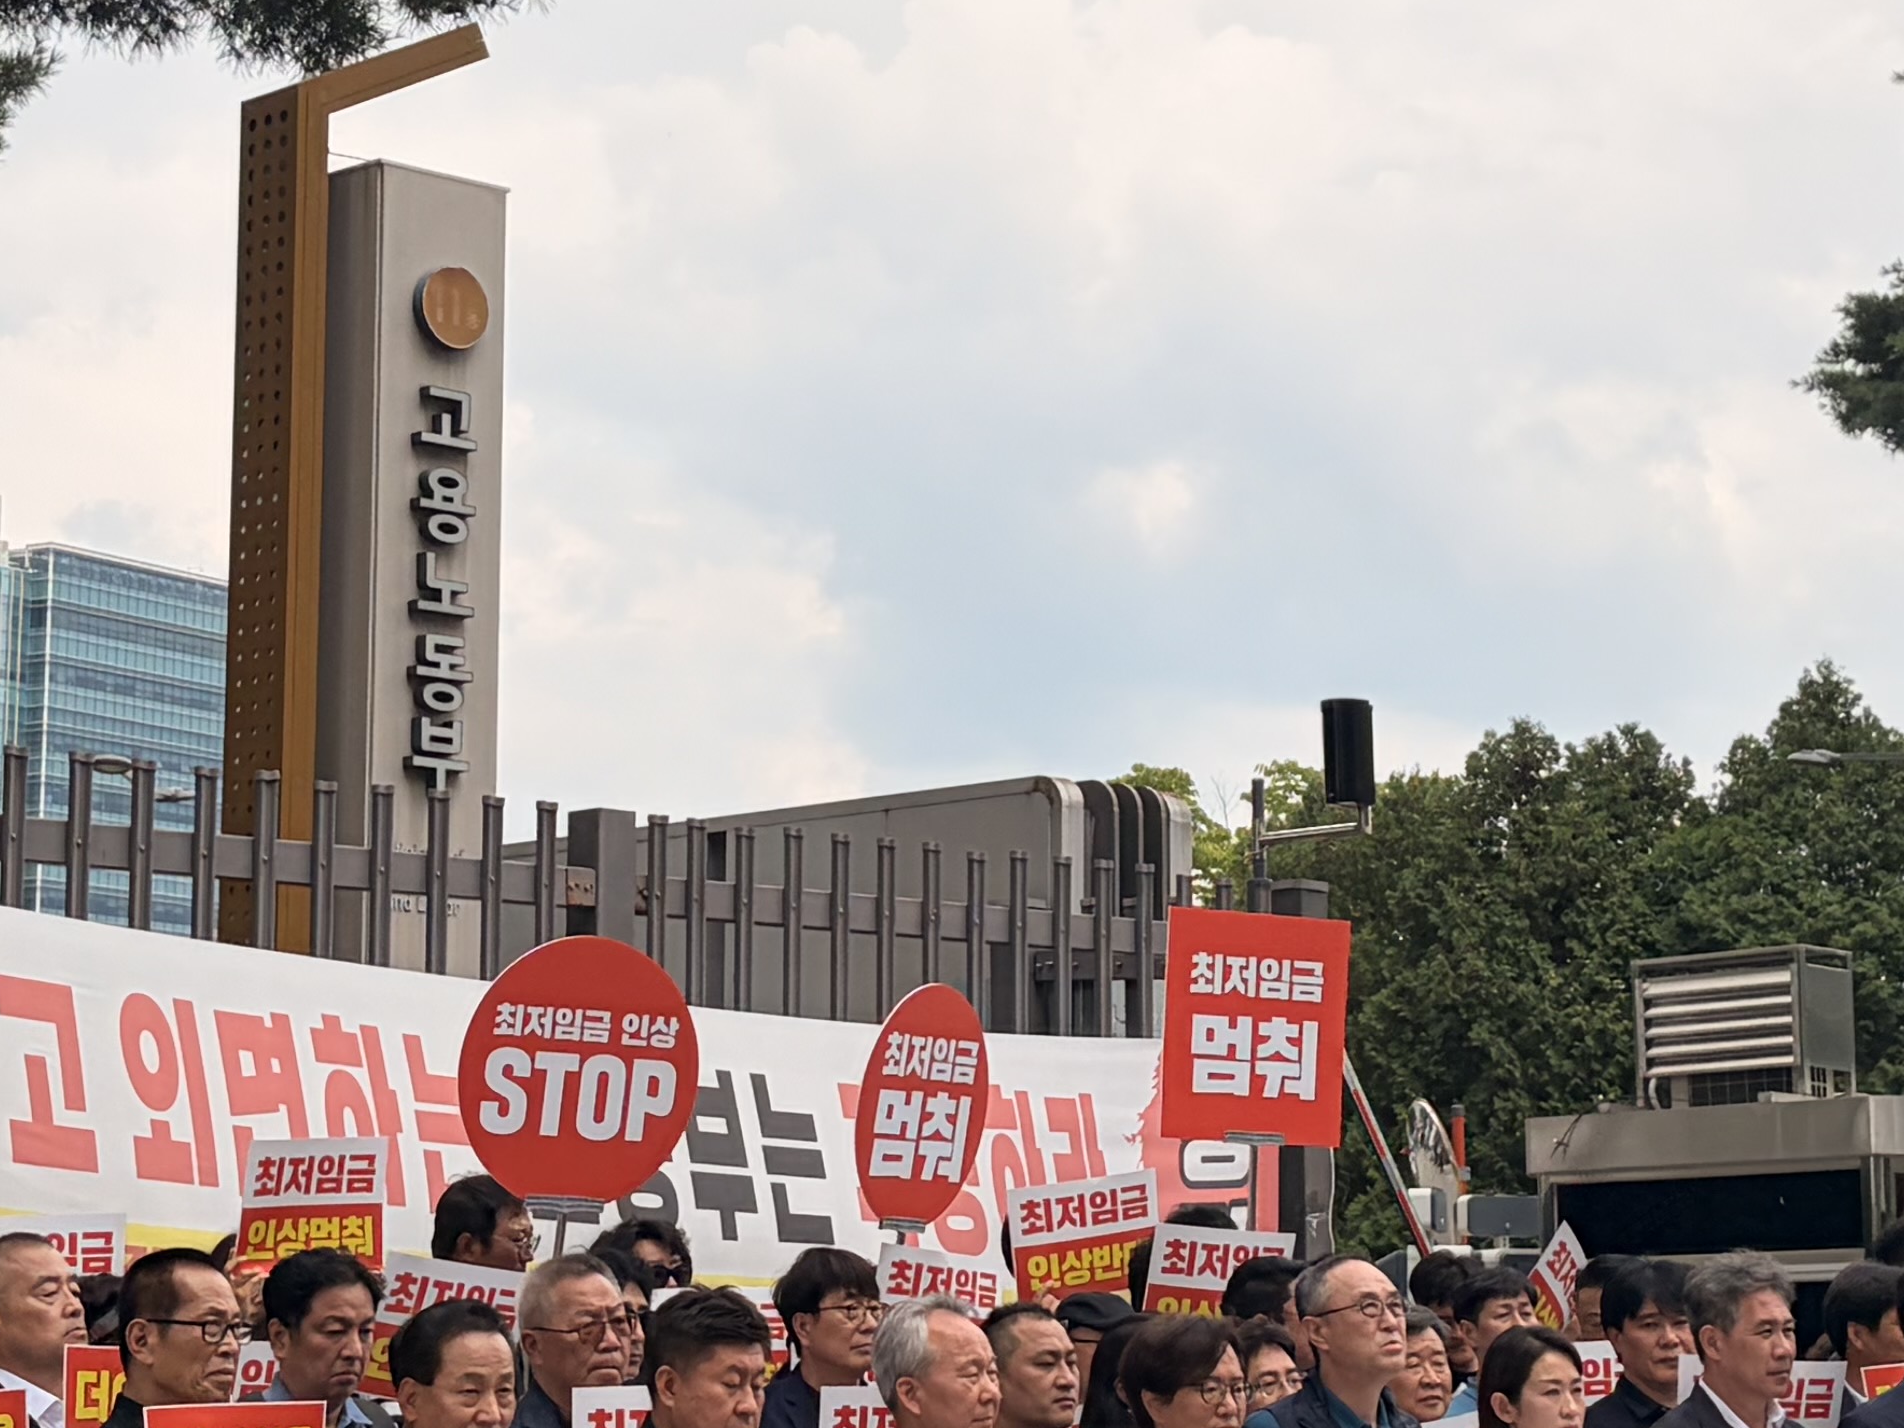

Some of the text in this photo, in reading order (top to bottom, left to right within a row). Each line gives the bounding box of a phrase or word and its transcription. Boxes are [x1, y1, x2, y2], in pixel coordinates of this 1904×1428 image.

[408, 384, 478, 791] 고용노동부
[1189, 950, 1326, 1004] 최저임금
[494, 1002, 679, 1049] 최저임금 인상
[882, 1032, 980, 1085] 최저임금
[1189, 1013, 1318, 1102] 멈춰
[479, 1047, 677, 1142] STOP
[869, 1089, 971, 1184] 멈춰
[253, 1154, 377, 1197] 최저임금
[1020, 1183, 1149, 1236] 최저임금
[246, 1215, 375, 1261] 인상멈춰
